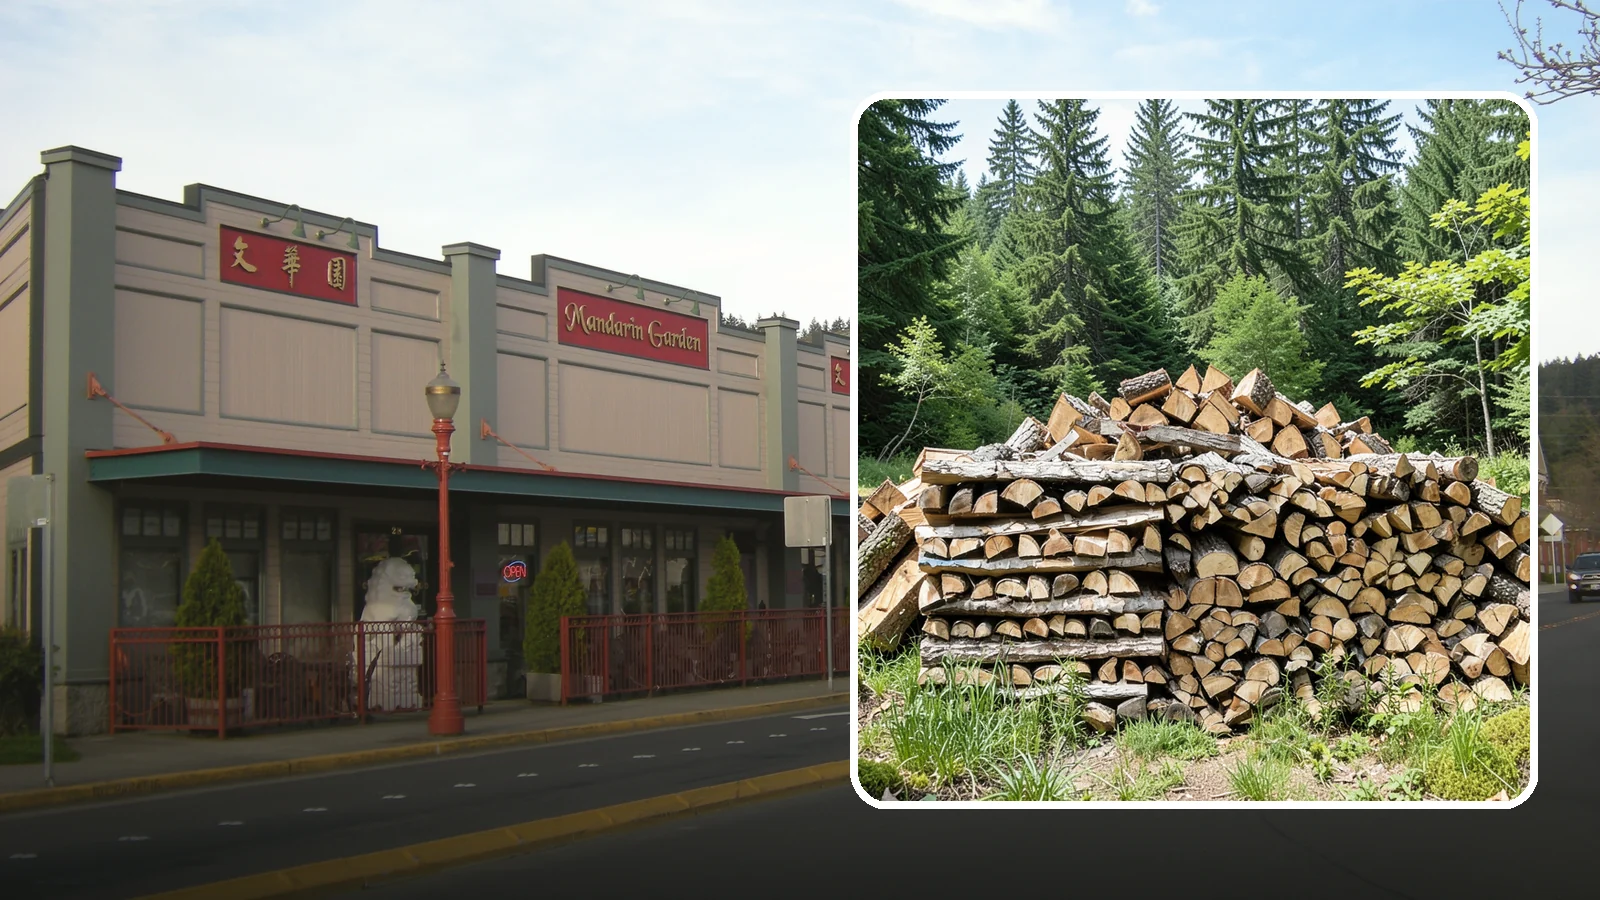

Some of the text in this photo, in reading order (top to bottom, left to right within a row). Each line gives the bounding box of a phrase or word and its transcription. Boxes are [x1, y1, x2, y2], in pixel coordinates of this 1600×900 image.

[230, 235, 346, 291] 文華園
[564, 302, 701, 352] Mandarin Garden
[503, 565, 527, 578] OPEN
